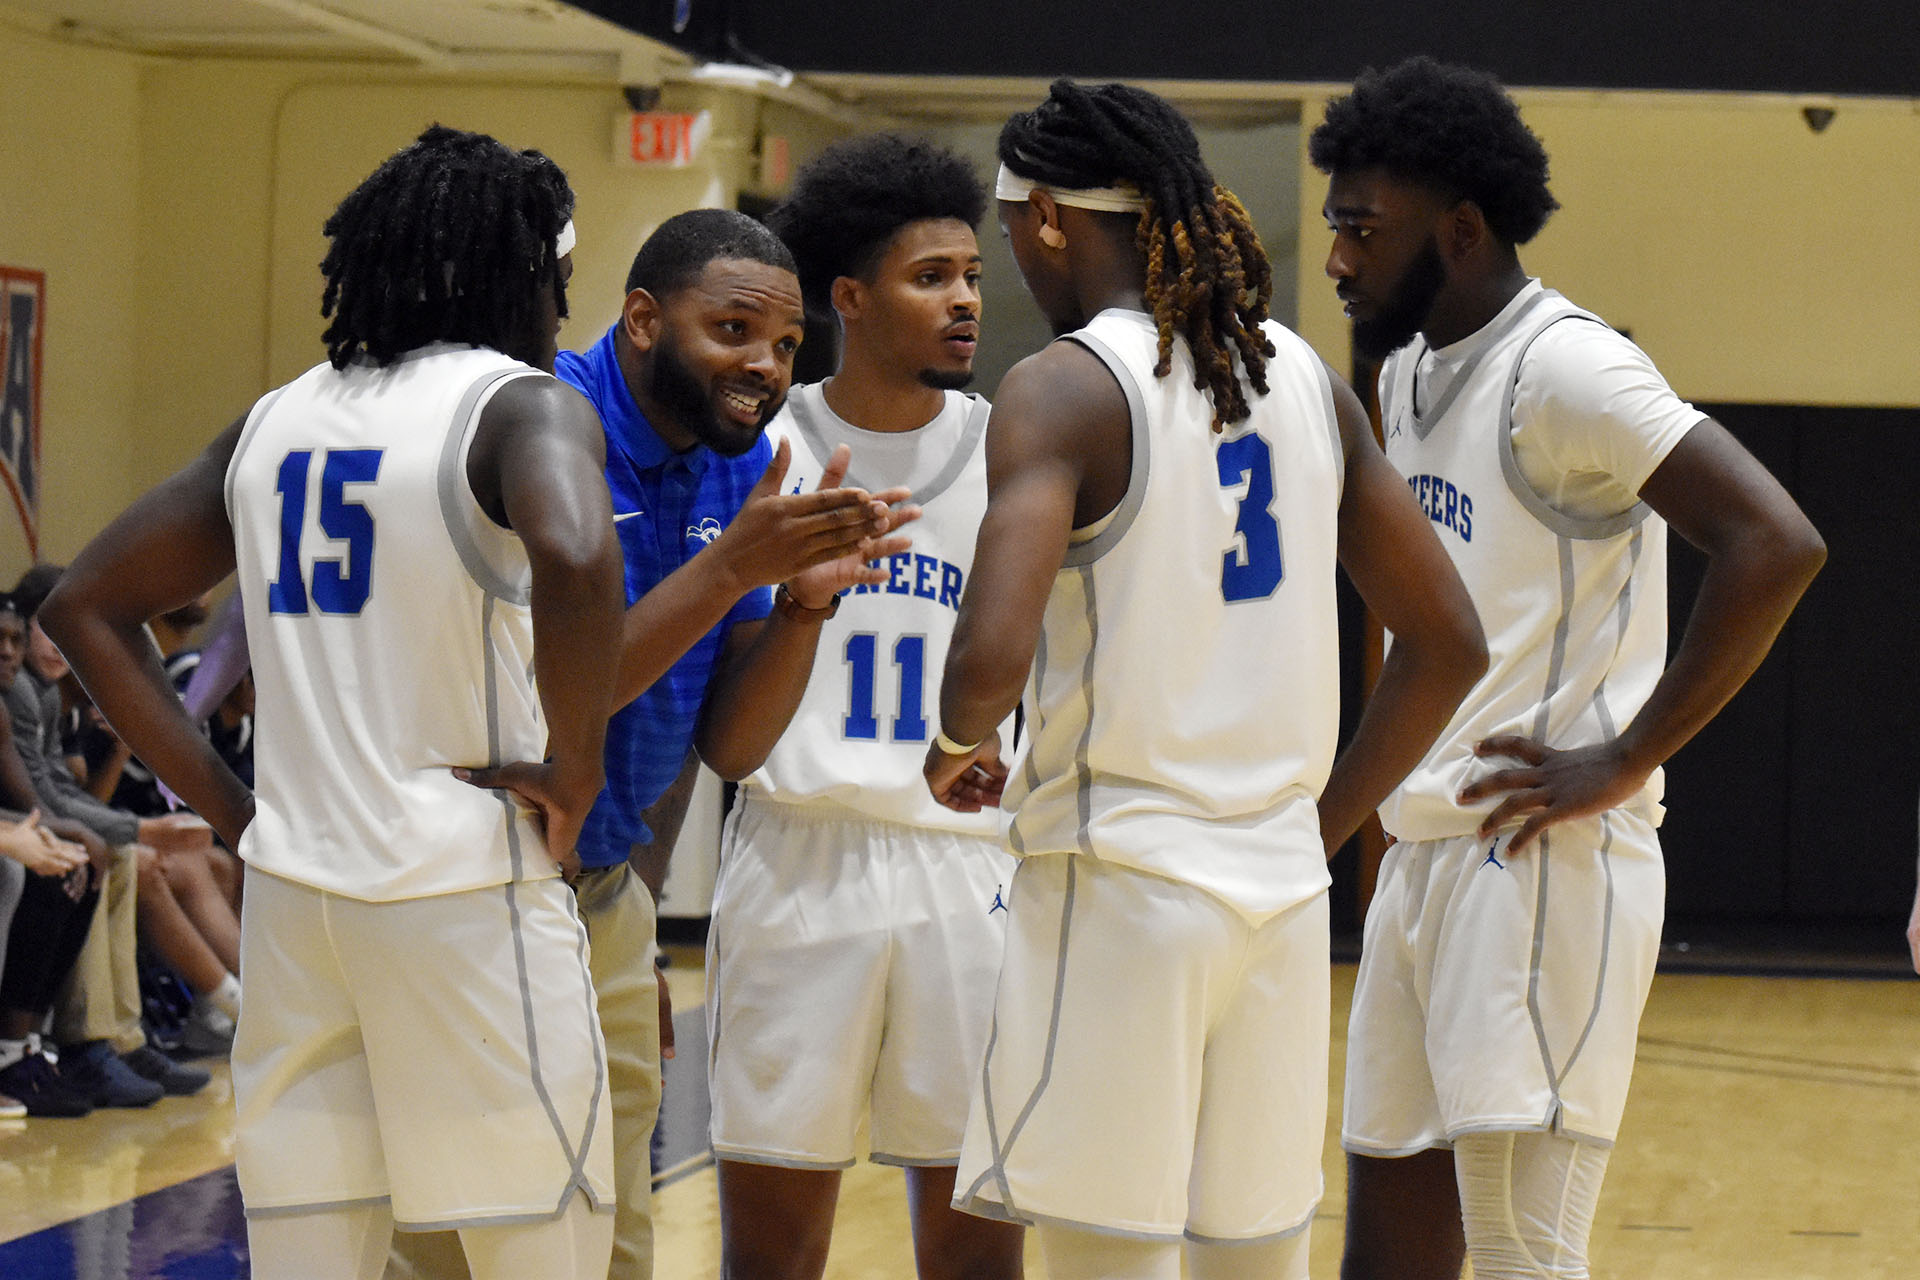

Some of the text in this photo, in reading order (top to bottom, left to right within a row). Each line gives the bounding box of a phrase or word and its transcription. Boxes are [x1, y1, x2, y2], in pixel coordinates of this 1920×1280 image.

[631, 112, 697, 163] EXIT
[268, 446, 388, 617] 15
[1216, 429, 1286, 606] 3
[840, 552, 963, 612] EER
[841, 630, 929, 745] 11
